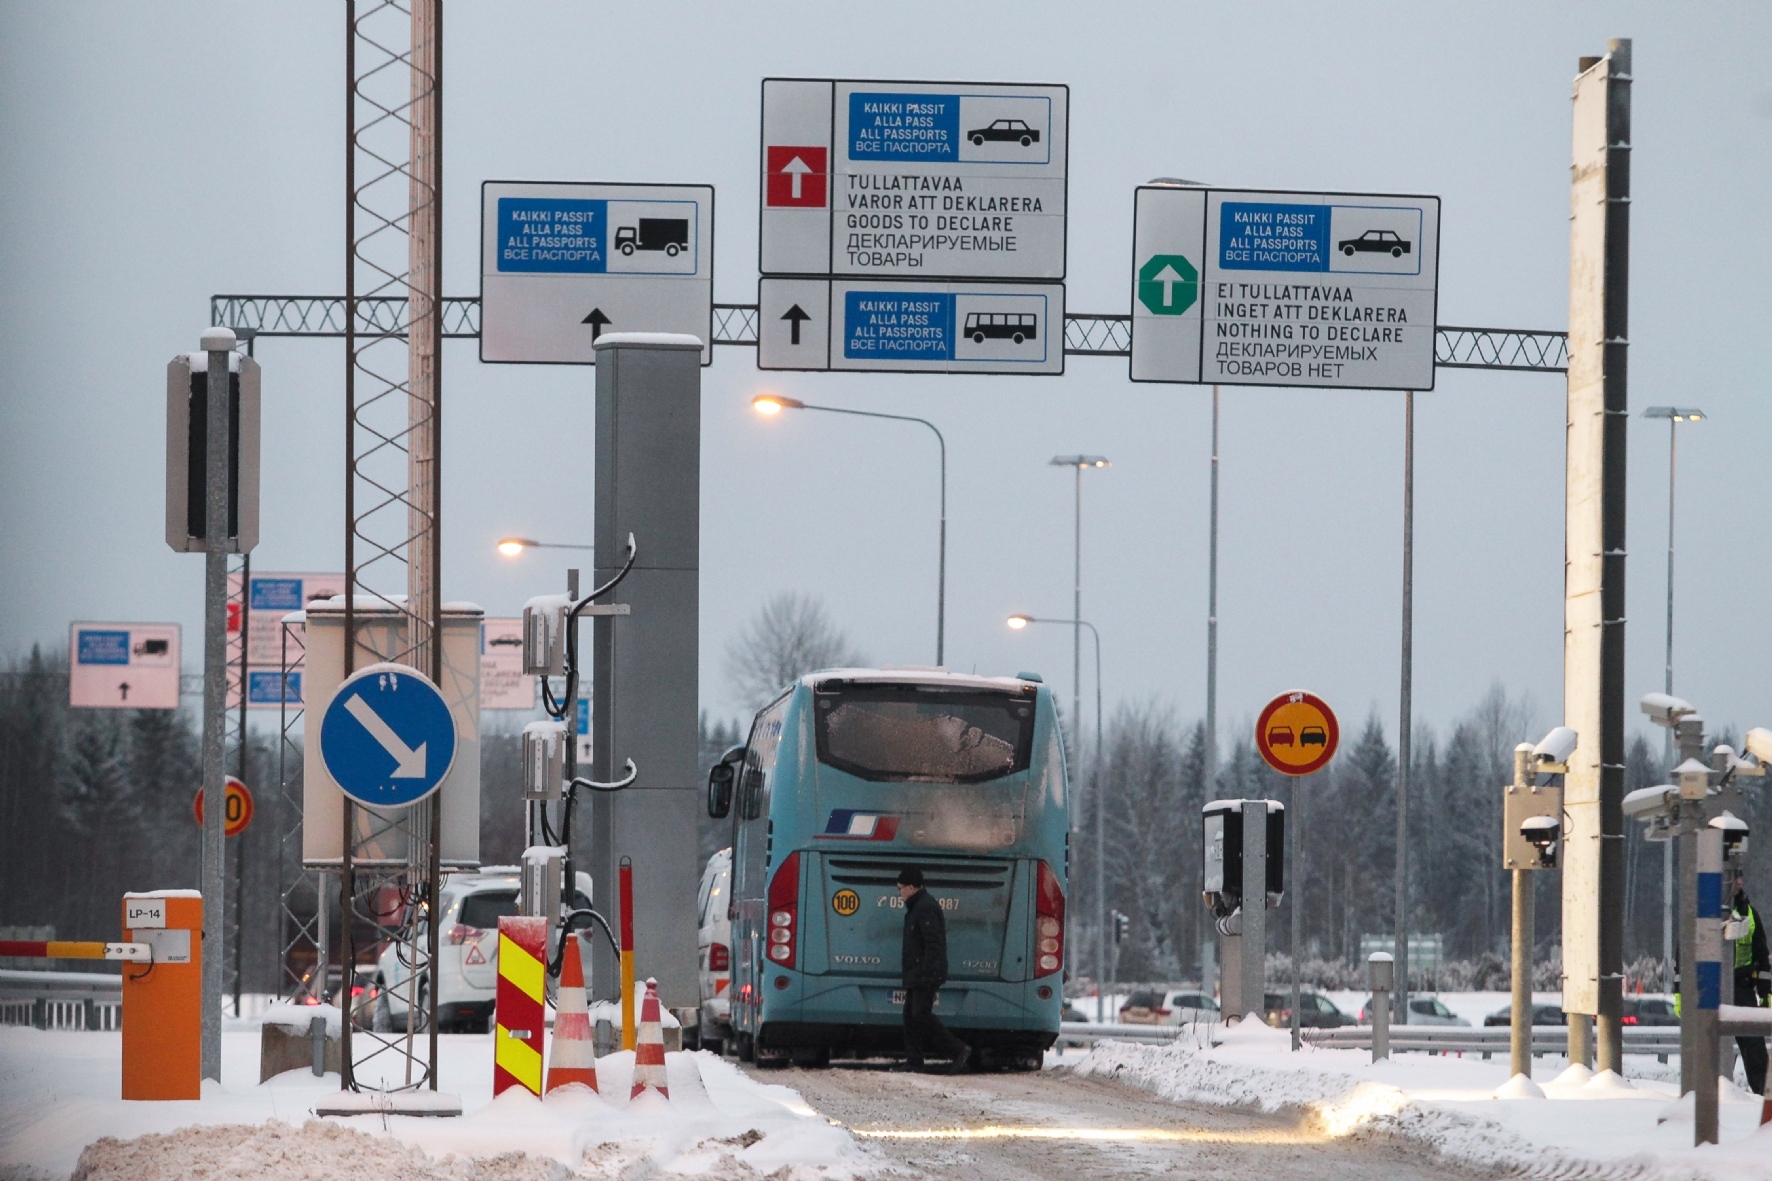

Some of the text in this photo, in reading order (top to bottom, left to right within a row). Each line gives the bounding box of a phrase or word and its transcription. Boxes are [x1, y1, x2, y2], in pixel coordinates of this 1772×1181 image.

[864, 103, 944, 114] KAIKKI PASSIT
[874, 116, 934, 127] ALLA PASS
[860, 128, 947, 140] ALL PASSPORTS
[856, 141, 950, 153] ВСЕ ПАСПОРТА
[848, 174, 962, 192] TULLATTAVAA
[848, 194, 1043, 212] VAROR ATT DEKLARERA
[512, 211, 594, 222] KAIKKI PASSIT
[1234, 212, 1315, 225] KAIKKI PASSIT
[847, 214, 1013, 232] GOODS TO DECLARE
[523, 224, 583, 235] ALLA PASS
[1245, 225, 1303, 237] ALLA PASS
[508, 237, 597, 248] ALL PASSPORTS
[847, 233, 1017, 251] ДЕКЛАРИРУЕМЫЕ
[1230, 237, 1317, 251] ALL PASSPORTS
[504, 249, 600, 261] ВСЕ ПАСПОРТА
[847, 251, 923, 267] ТОВАРЫ
[1225, 250, 1320, 263] ВСЕ ПАСПОРТА
[1218, 283, 1353, 302] EI TULLATTAVAA
[860, 301, 940, 312] KAIKKI PASSIT
[1217, 303, 1407, 323] INGET ATT DEKLARERA
[869, 314, 929, 325] ALLA PASS
[855, 327, 943, 339] ALL PASSPORTS
[1216, 323, 1403, 342] NOTHING TO DECLARE
[851, 339, 946, 351] ВСЕ ПАСПОРТА
[1216, 342, 1378, 361] ДЕКЛАРИРУЕМЫХ
[1216, 361, 1344, 379] ТОВАРОВ НЕТ
[226, 794, 241, 822] 0
[889, 896, 960, 910] 05 987
[130, 910, 160, 918] LP-14
[834, 955, 881, 965] VOLVO
